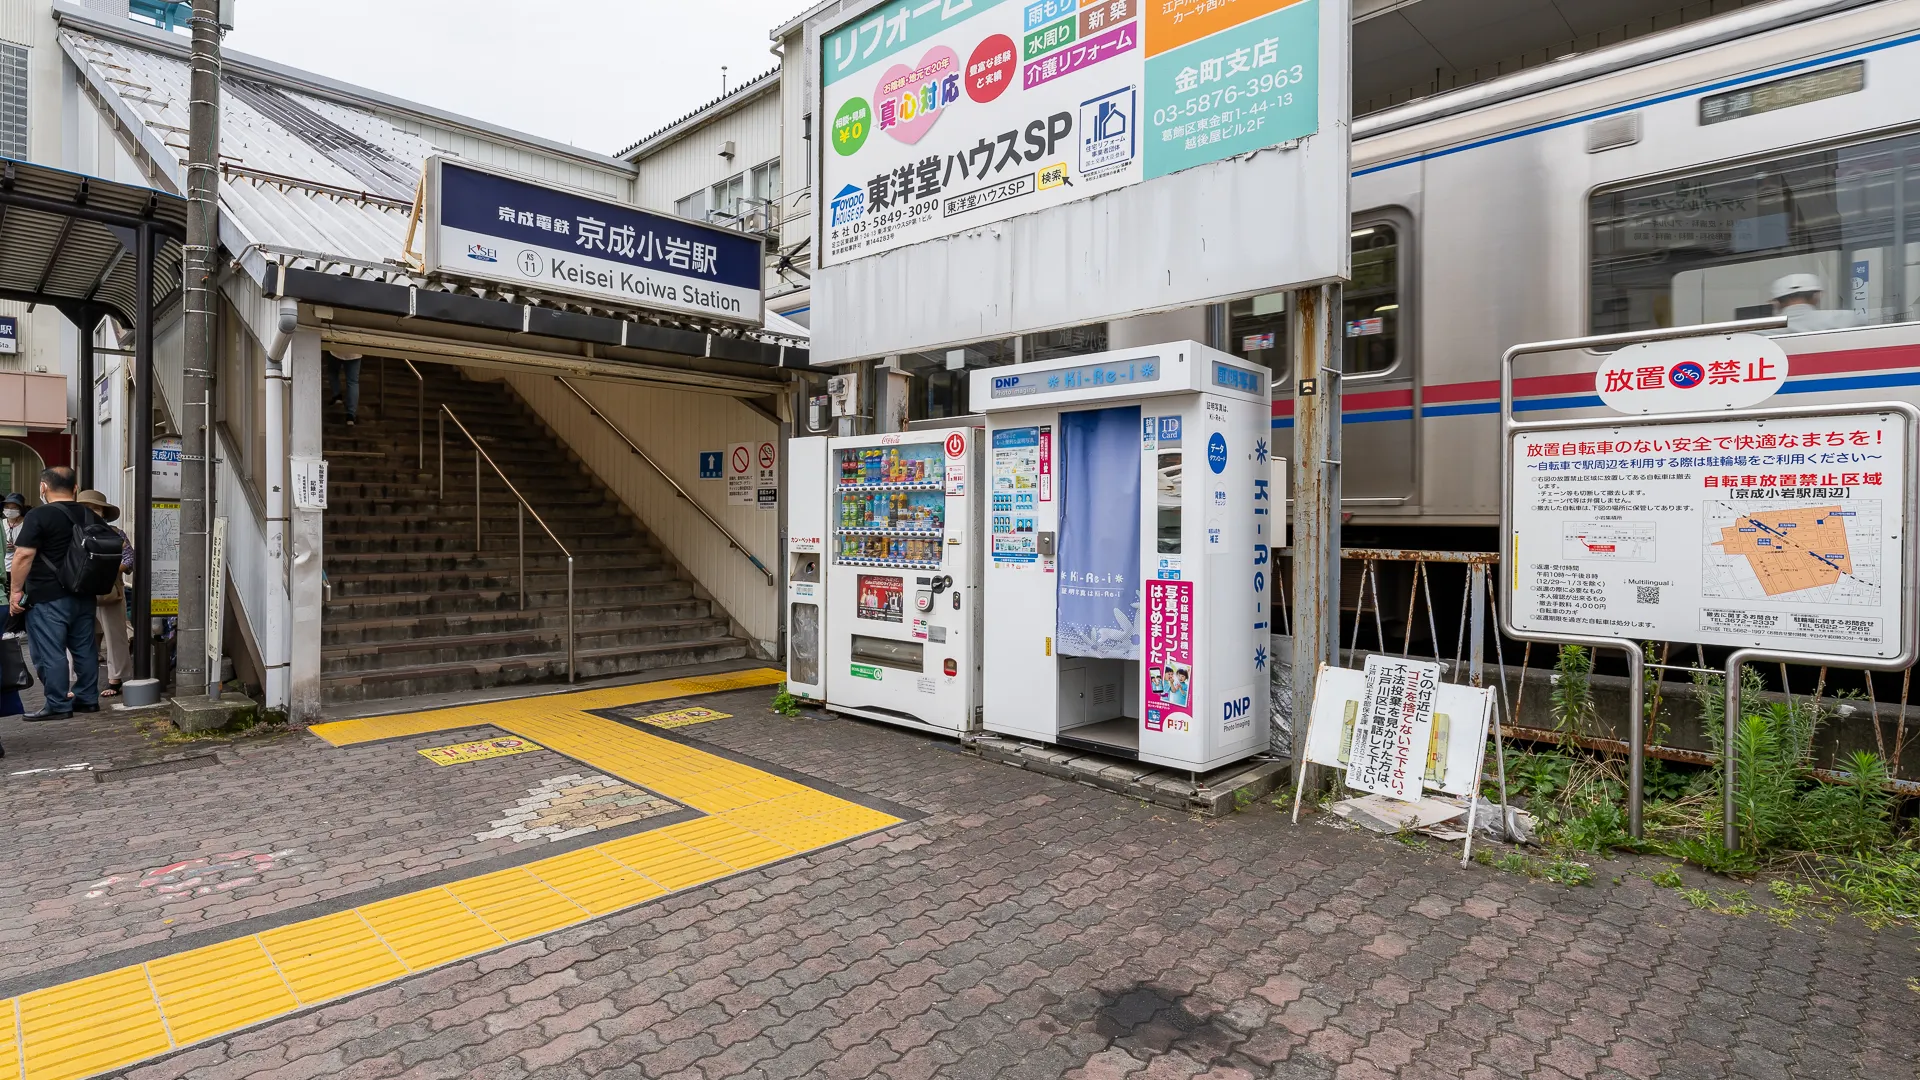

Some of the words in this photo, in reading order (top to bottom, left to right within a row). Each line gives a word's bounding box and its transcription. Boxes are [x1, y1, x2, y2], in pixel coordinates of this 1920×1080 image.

[1088, 0, 1127, 30] 新築
[1173, 0, 1236, 24] カーサ西小
[1028, 24, 1070, 54] 水周り
[969, 50, 1011, 77] 豊富な経験
[1027, 31, 1132, 85] 介護リフォーム
[1174, 36, 1279, 95] 金町支店
[976, 70, 1002, 89] と実績
[880, 73, 960, 131] 真心対応
[1153, 64, 1303, 127] 03-5876-3963
[1162, 92, 1293, 142] 葛飾区東金町1-44-13
[1184, 117, 1266, 151] 越後屋ビル2F
[867, 111, 1073, 214] 東洋堂ハウスSP
[1041, 169, 1062, 185] 検索
[947, 180, 1025, 214] 東洋堂ハウスSP
[853, 199, 938, 234] 03-5849-3090
[498, 205, 570, 235] 京成電鉄
[575, 215, 717, 275] 京成小岩駅
[524, 261, 536, 273] 11
[526, 253, 534, 261] KS
[551, 258, 614, 290] Keisei
[621, 274, 677, 301] Koiwa
[683, 284, 741, 313] Station
[995, 377, 1019, 389] DNP
[1064, 363, 1135, 388] Ki-Re-i
[1217, 366, 1259, 391] 証明写真
[1605, 365, 1665, 394] 放置
[1708, 357, 1777, 386] 禁止
[1161, 432, 1178, 440] Card
[1162, 418, 1179, 433] ID
[1211, 443, 1225, 454] データ
[1527, 430, 1884, 458] 放置自転車のない安全で快適なまちを!
[1704, 472, 1883, 488] 自転車放置禁止区域
[1729, 487, 1850, 499] 【京成小岩駅周辺】
[1215, 491, 1226, 500] 背景色
[1254, 480, 1268, 629] Ki-Re-i
[1628, 578, 1669, 586] Multilingual
[1150, 585, 1163, 664] はじめました
[1165, 585, 1178, 665] 写真プリント
[1180, 586, 1189, 659] この証明写真機で
[1224, 696, 1250, 721] DNP
[1416, 669, 1434, 723] この付近に
[1223, 723, 1234, 732] Photo
[1234, 719, 1250, 731] Imaging
[1363, 667, 1393, 790] 江戸川区に電話して下さい。
[1377, 664, 1408, 788] 不法投棄を見かけた方は、
[1391, 671, 1420, 796] ゴミを捨てないで下さい。
